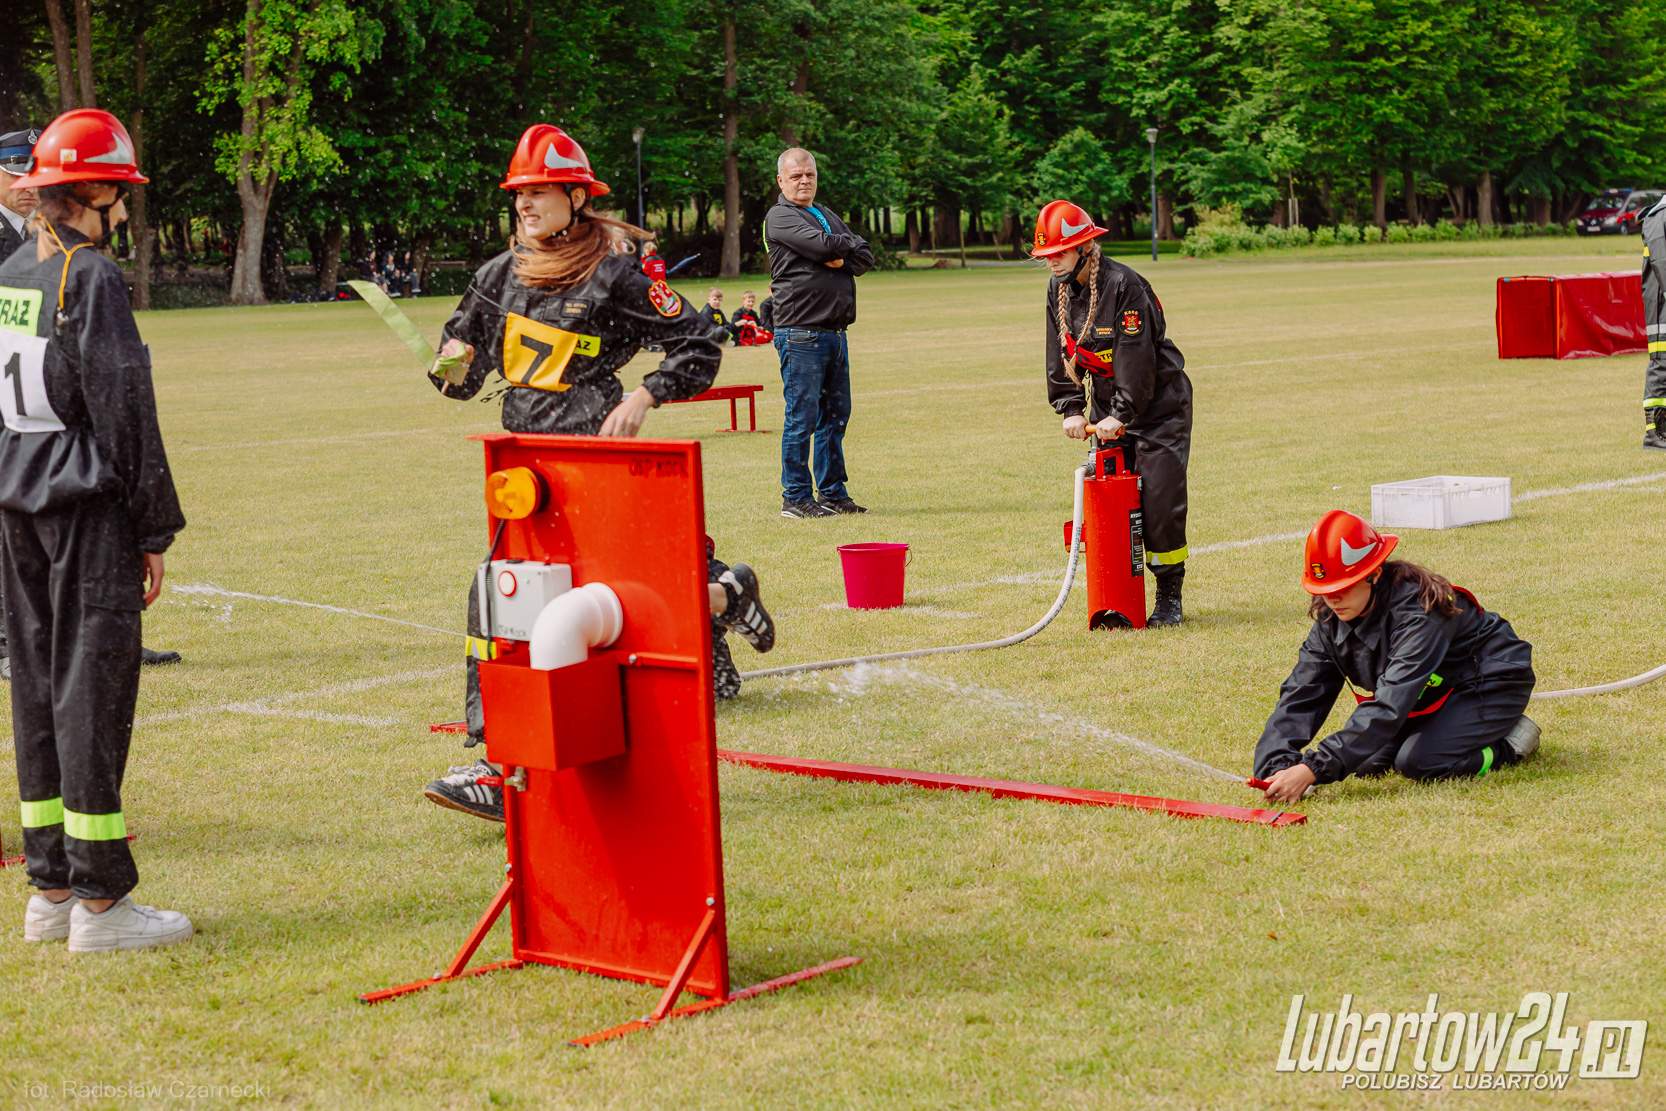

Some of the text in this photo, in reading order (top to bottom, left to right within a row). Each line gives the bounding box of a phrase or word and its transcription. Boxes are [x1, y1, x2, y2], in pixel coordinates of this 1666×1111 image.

[0, 299, 31, 326] RAZ
[4, 351, 28, 417] 1
[519, 333, 554, 385] 7
